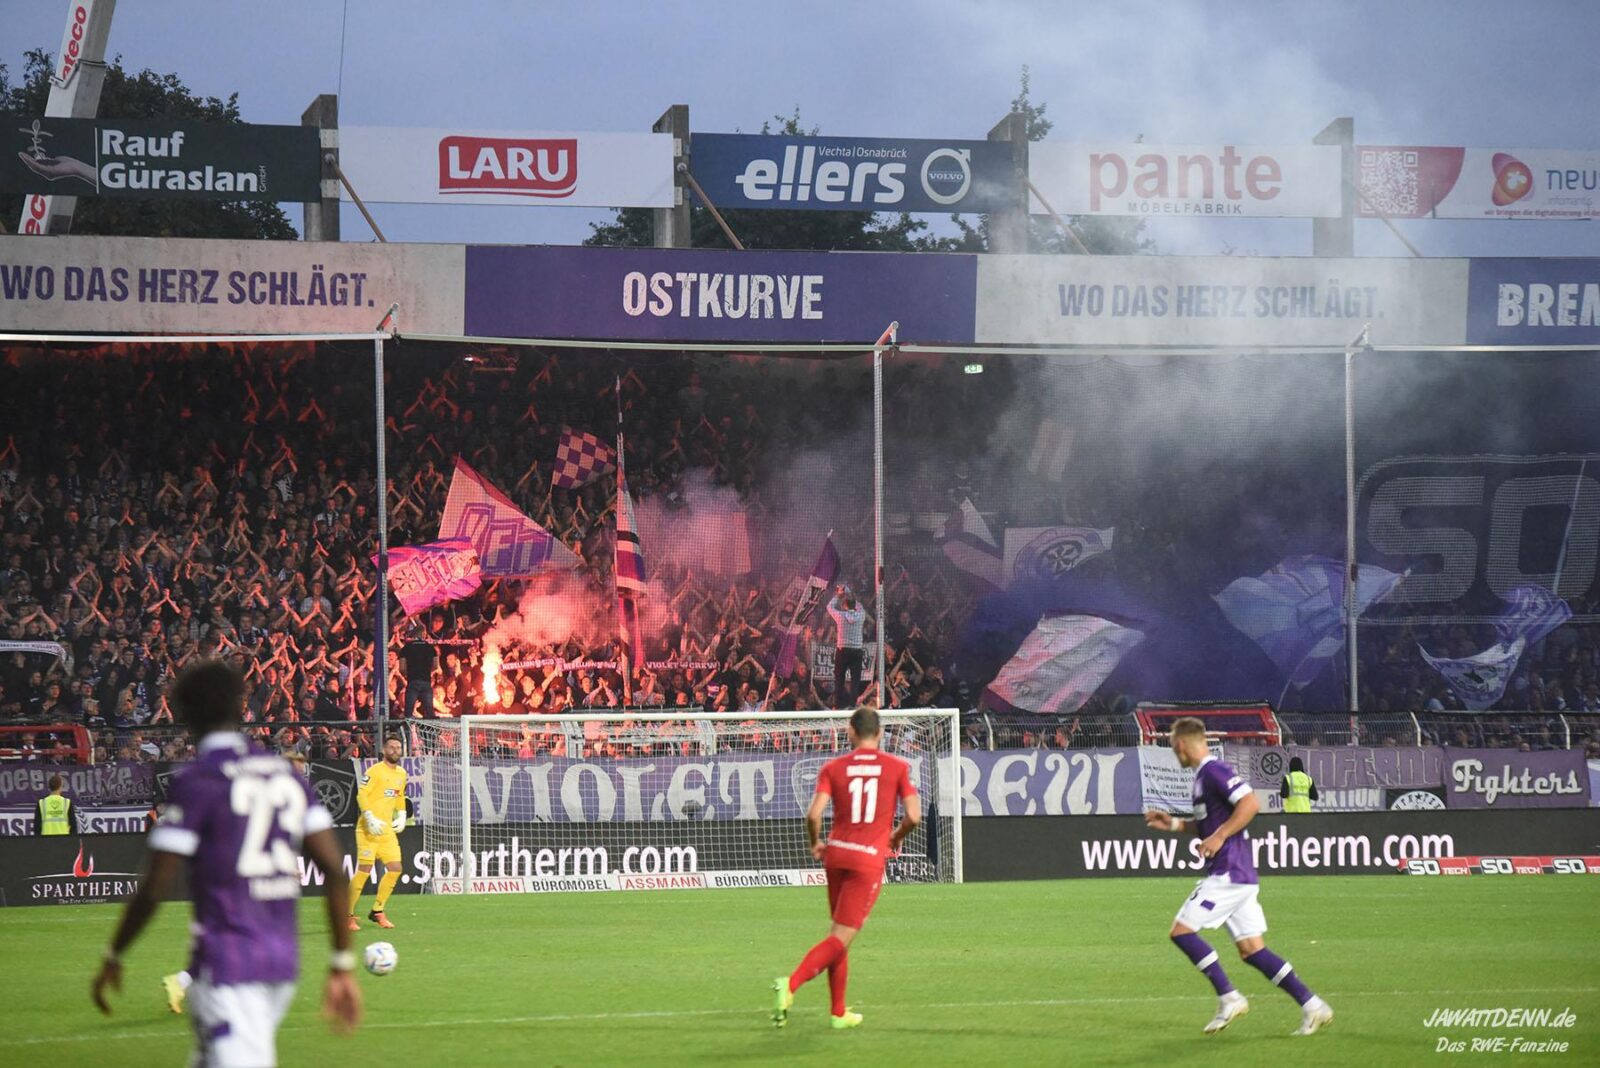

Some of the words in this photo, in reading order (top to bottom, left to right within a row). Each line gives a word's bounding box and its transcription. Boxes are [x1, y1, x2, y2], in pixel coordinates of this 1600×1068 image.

[102, 129, 184, 157] Rauf
[101, 161, 258, 192] Güraslan
[448, 145, 569, 182] LARU
[736, 145, 906, 203] ellers
[929, 172, 964, 181] VOLVO
[1090, 146, 1283, 212] pante
[1546, 170, 1600, 190] neu
[1128, 201, 1243, 214] MÖBELFABRIK
[1, 265, 54, 300] WO
[64, 267, 129, 302] DAS
[138, 269, 219, 304] HERZ
[228, 264, 374, 307] SCHLÄGT.
[623, 271, 824, 320] OSTKURVE
[1058, 284, 1104, 317] WO
[1111, 284, 1169, 318] DAS
[1175, 285, 1246, 318] HERZ
[1254, 279, 1385, 319] SCHLÄGT.
[1452, 759, 1582, 804] Fighters
[848, 777, 878, 823] 11
[231, 774, 307, 877] 23
[1408, 860, 1441, 875] SO
[1442, 867, 1468, 875] TECH
[1480, 859, 1514, 874] SO
[1516, 867, 1541, 875] TECH
[1554, 858, 1586, 874] SO
[32, 881, 138, 898] SPARTHERM
[532, 877, 612, 892] BÜROMÖBEL
[625, 874, 703, 891] ASSMANN
[714, 872, 793, 889] BÜROMÖBEL
